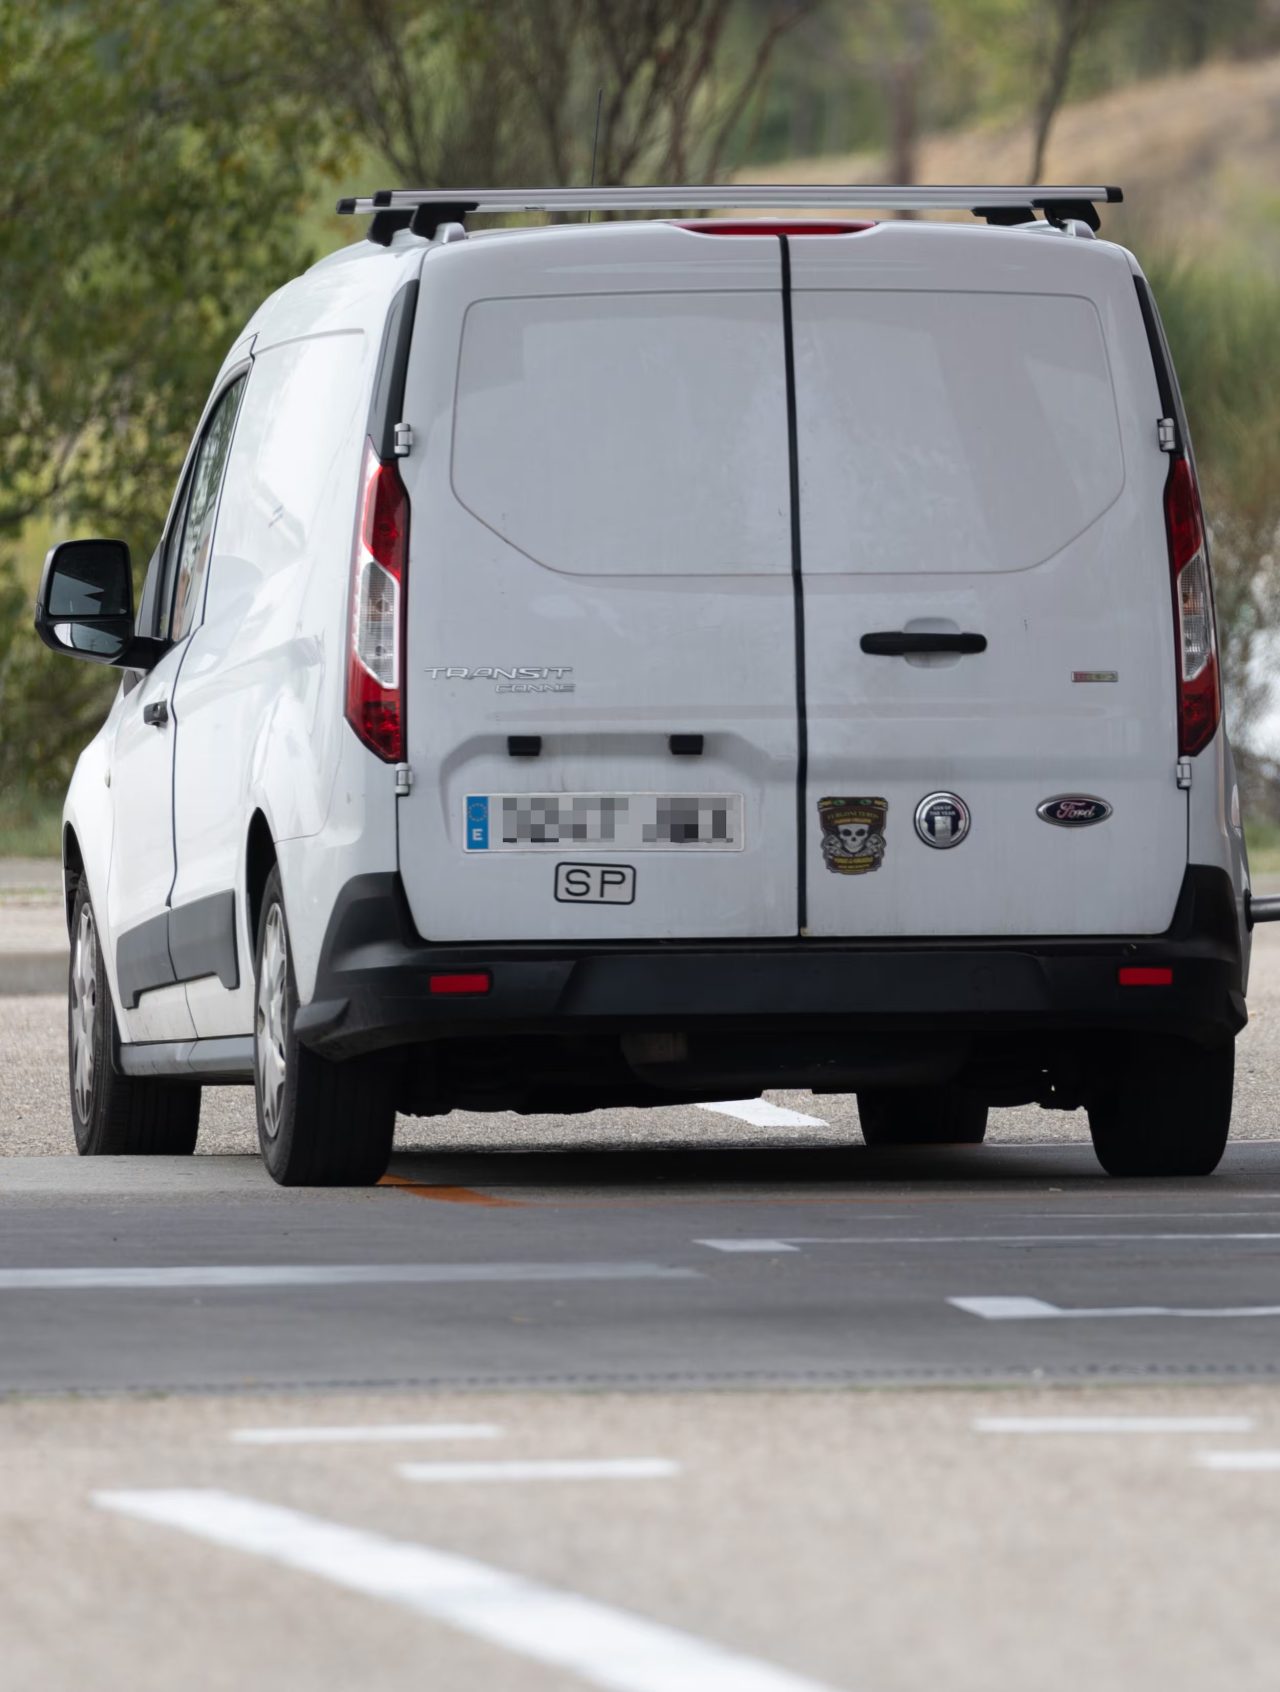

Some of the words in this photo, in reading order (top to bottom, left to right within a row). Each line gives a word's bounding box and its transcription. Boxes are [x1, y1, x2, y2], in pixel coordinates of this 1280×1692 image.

[424, 667, 573, 680] TRANSIT
[1056, 801, 1096, 819] Ford
[472, 828, 483, 841] E
[564, 868, 627, 899] SP
